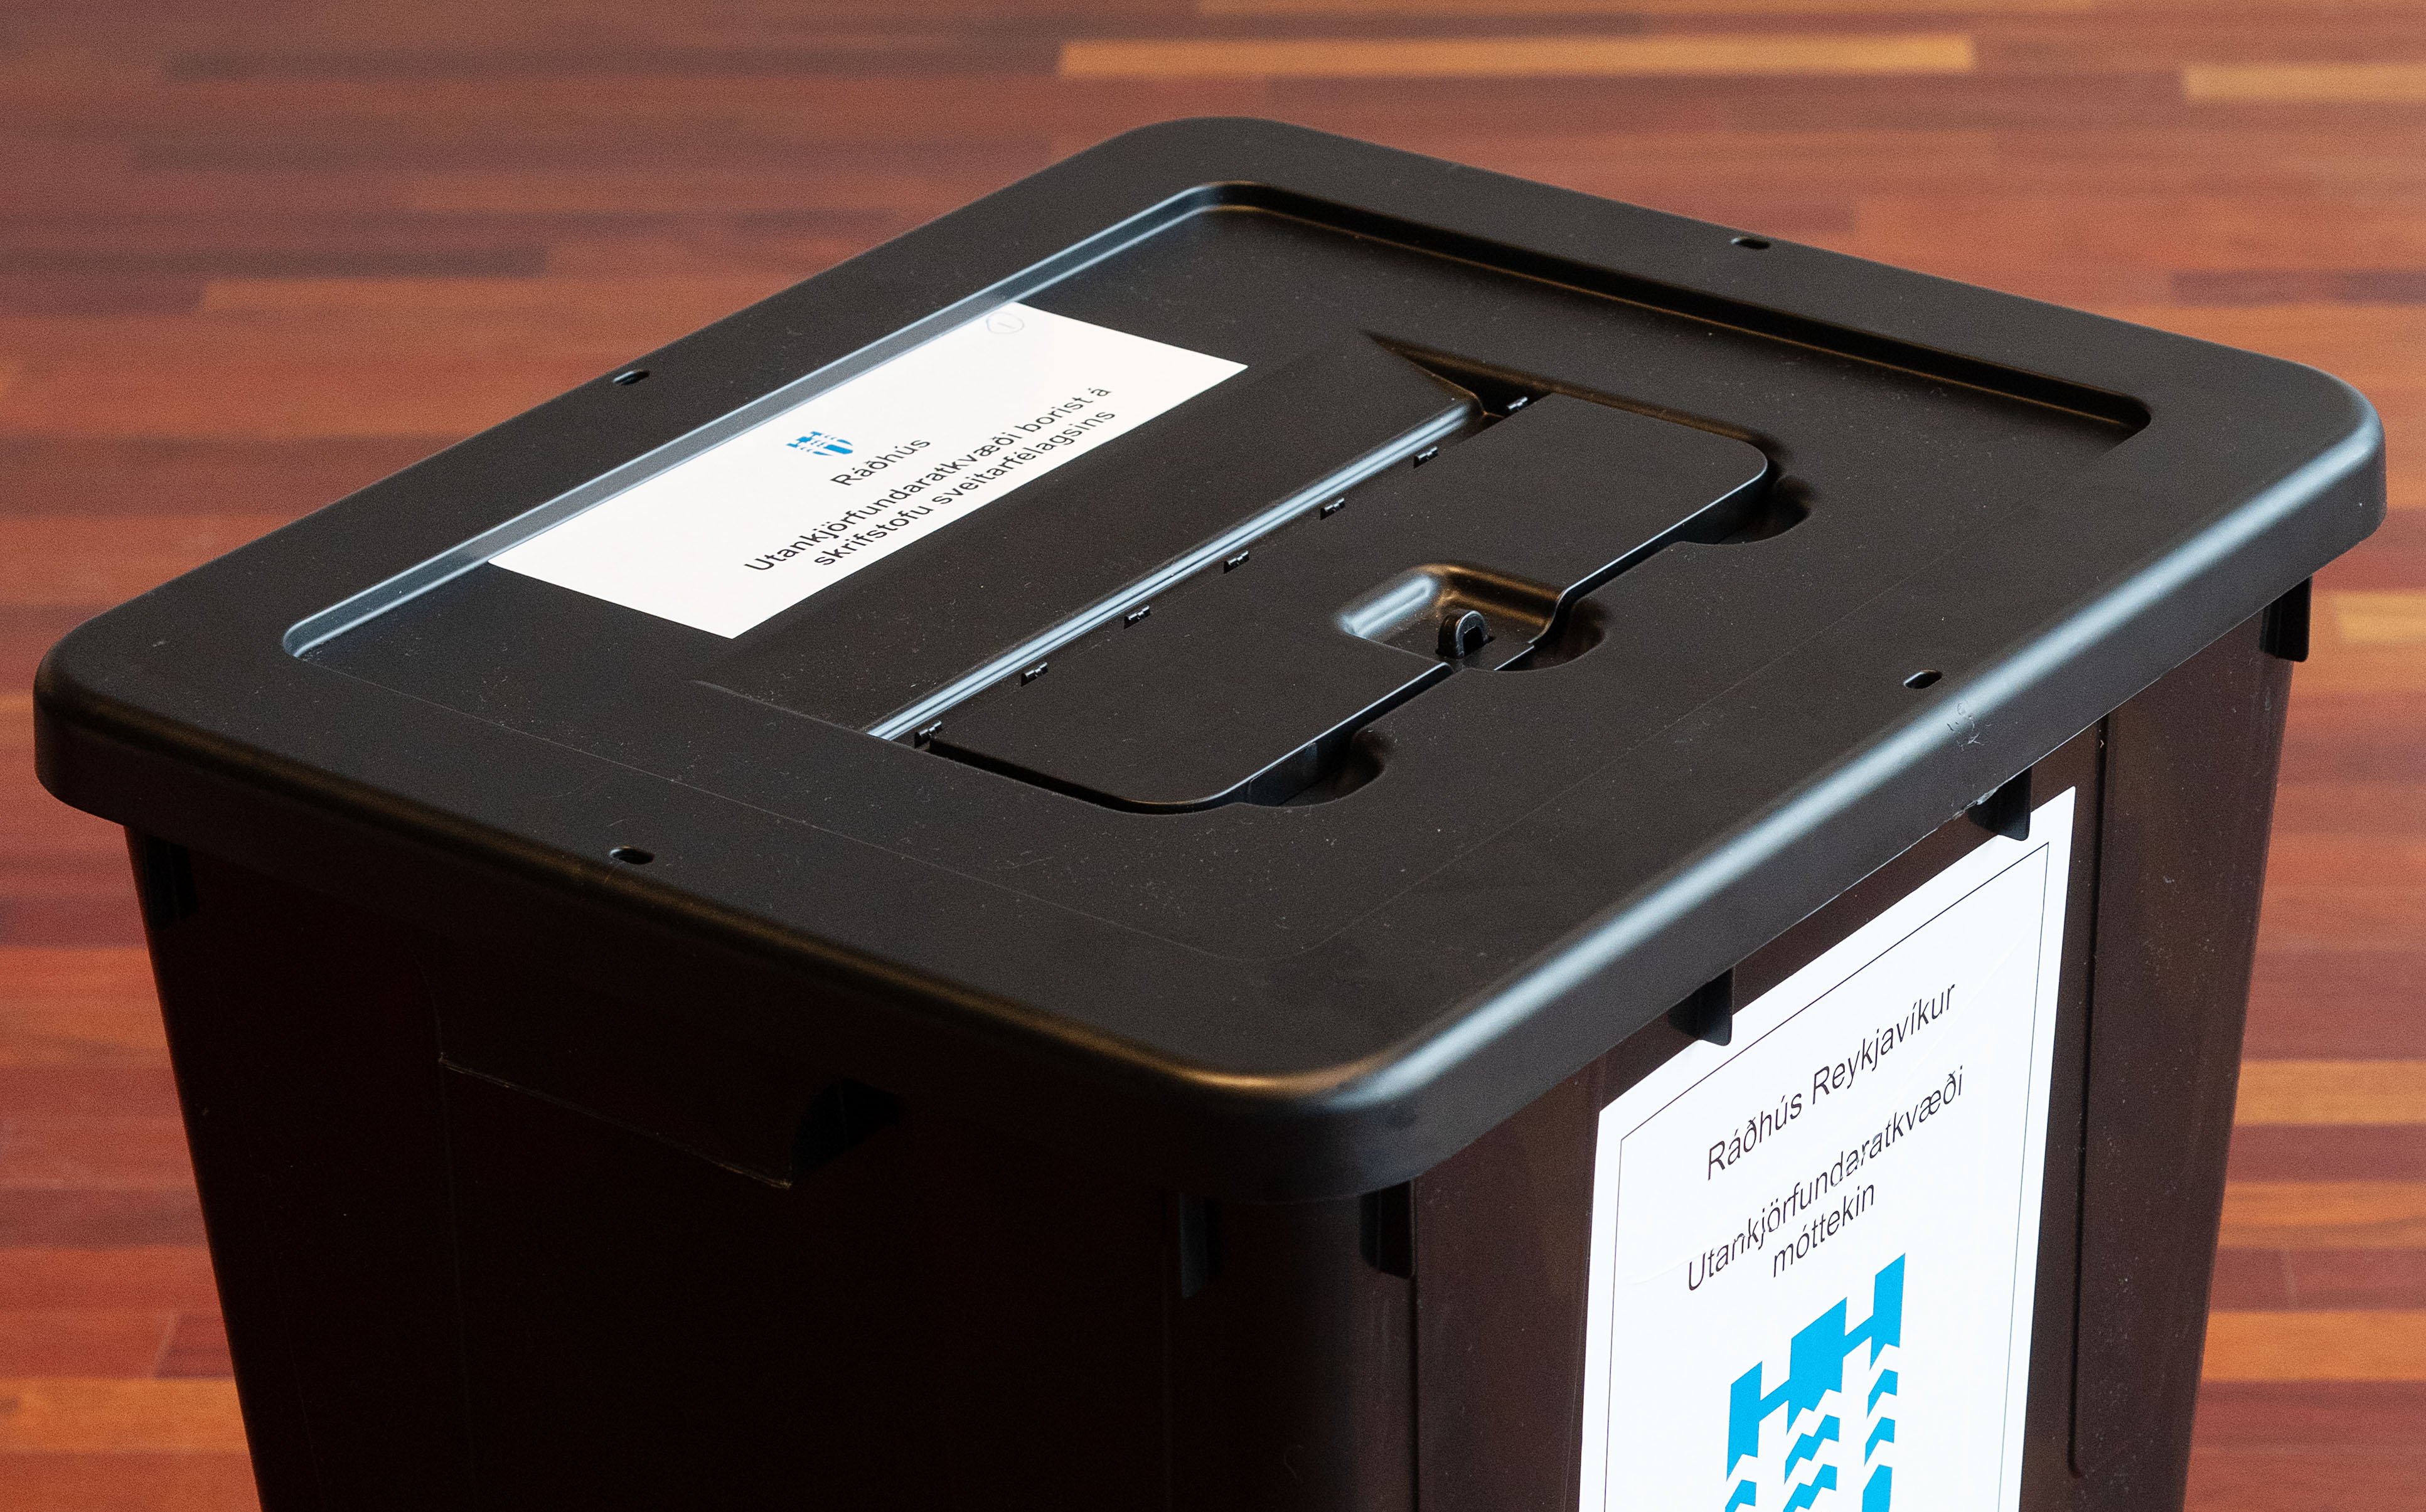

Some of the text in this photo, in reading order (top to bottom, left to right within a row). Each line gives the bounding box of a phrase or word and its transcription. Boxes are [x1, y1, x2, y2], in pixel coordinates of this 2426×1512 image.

[744, 387, 1111, 572] Utankjörfundaratkvæði borist á
[814, 412, 1116, 567] skrifstofu sveitarfélagsins
[830, 440, 931, 487] Ráðhús
[1707, 983, 1956, 1181] Ráðhús Reykjavíkur
[1688, 1065, 1963, 1292] Utankjörfundaratkvæði
[1773, 1183, 1875, 1279] móttekin
